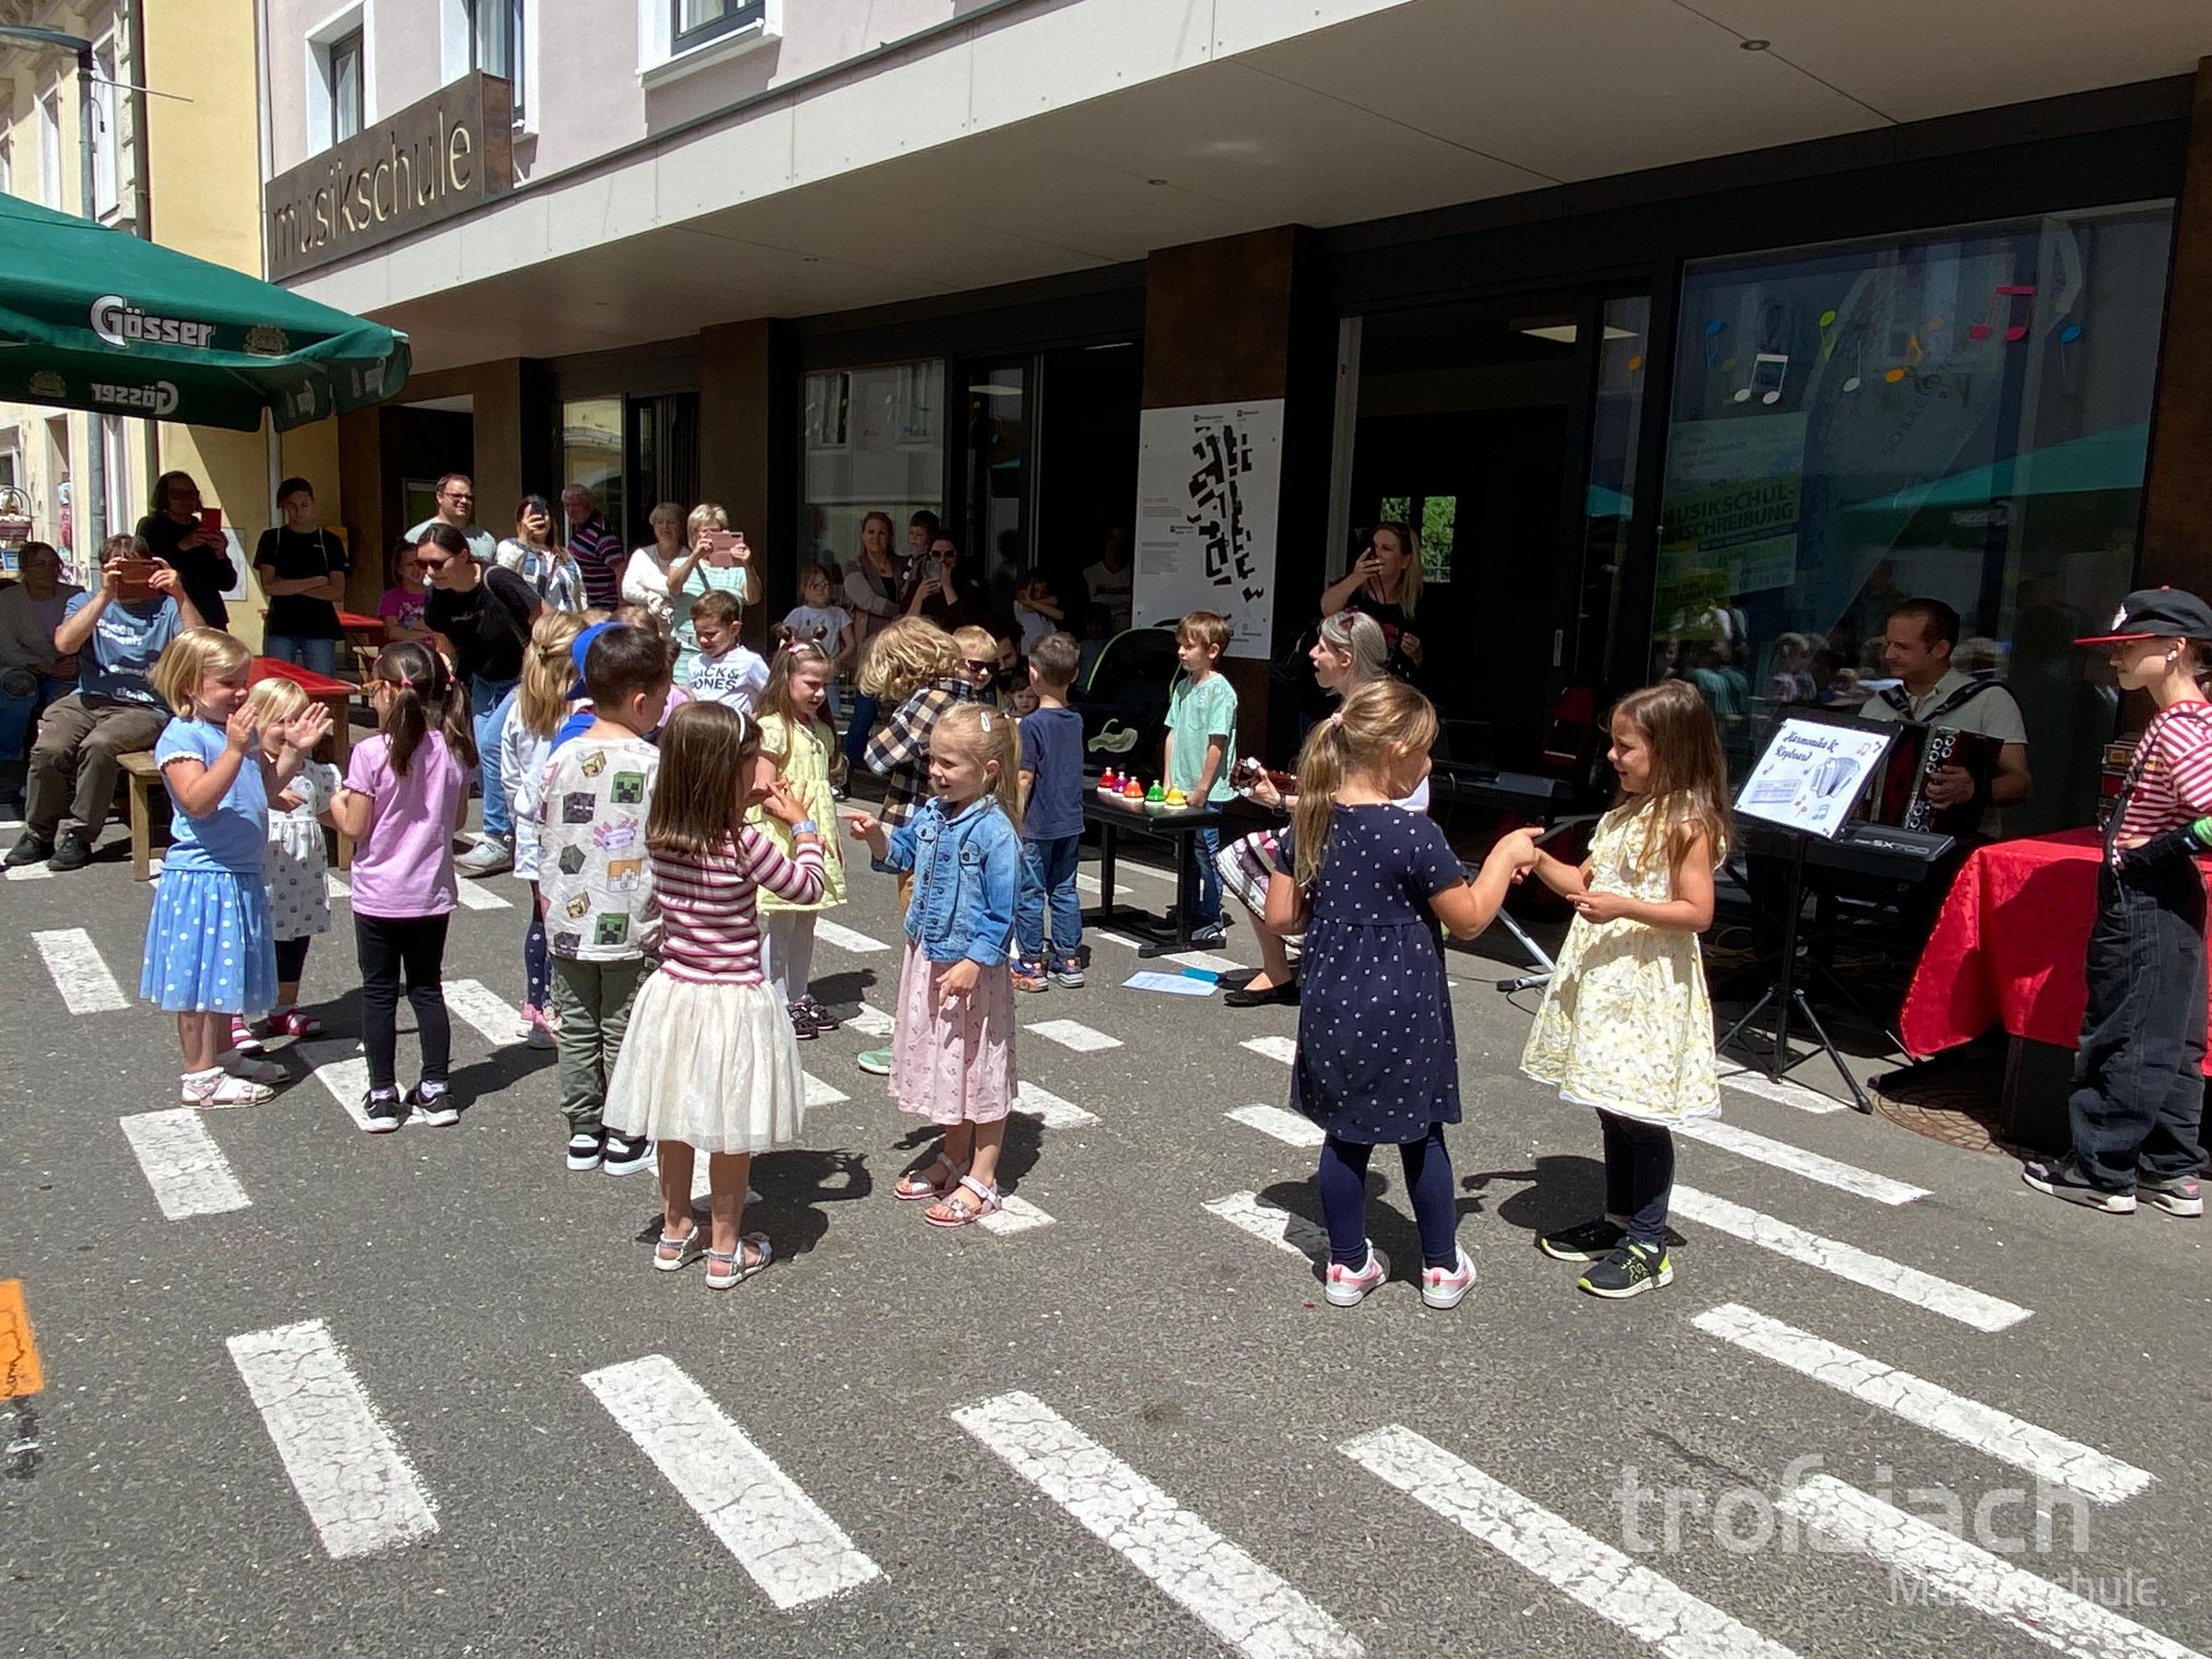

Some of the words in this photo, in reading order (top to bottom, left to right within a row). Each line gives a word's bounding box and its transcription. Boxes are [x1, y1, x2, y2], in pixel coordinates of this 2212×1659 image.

[274, 105, 471, 262] musikschule
[90, 294, 215, 348] Gösser
[693, 677, 737, 691] ONES
